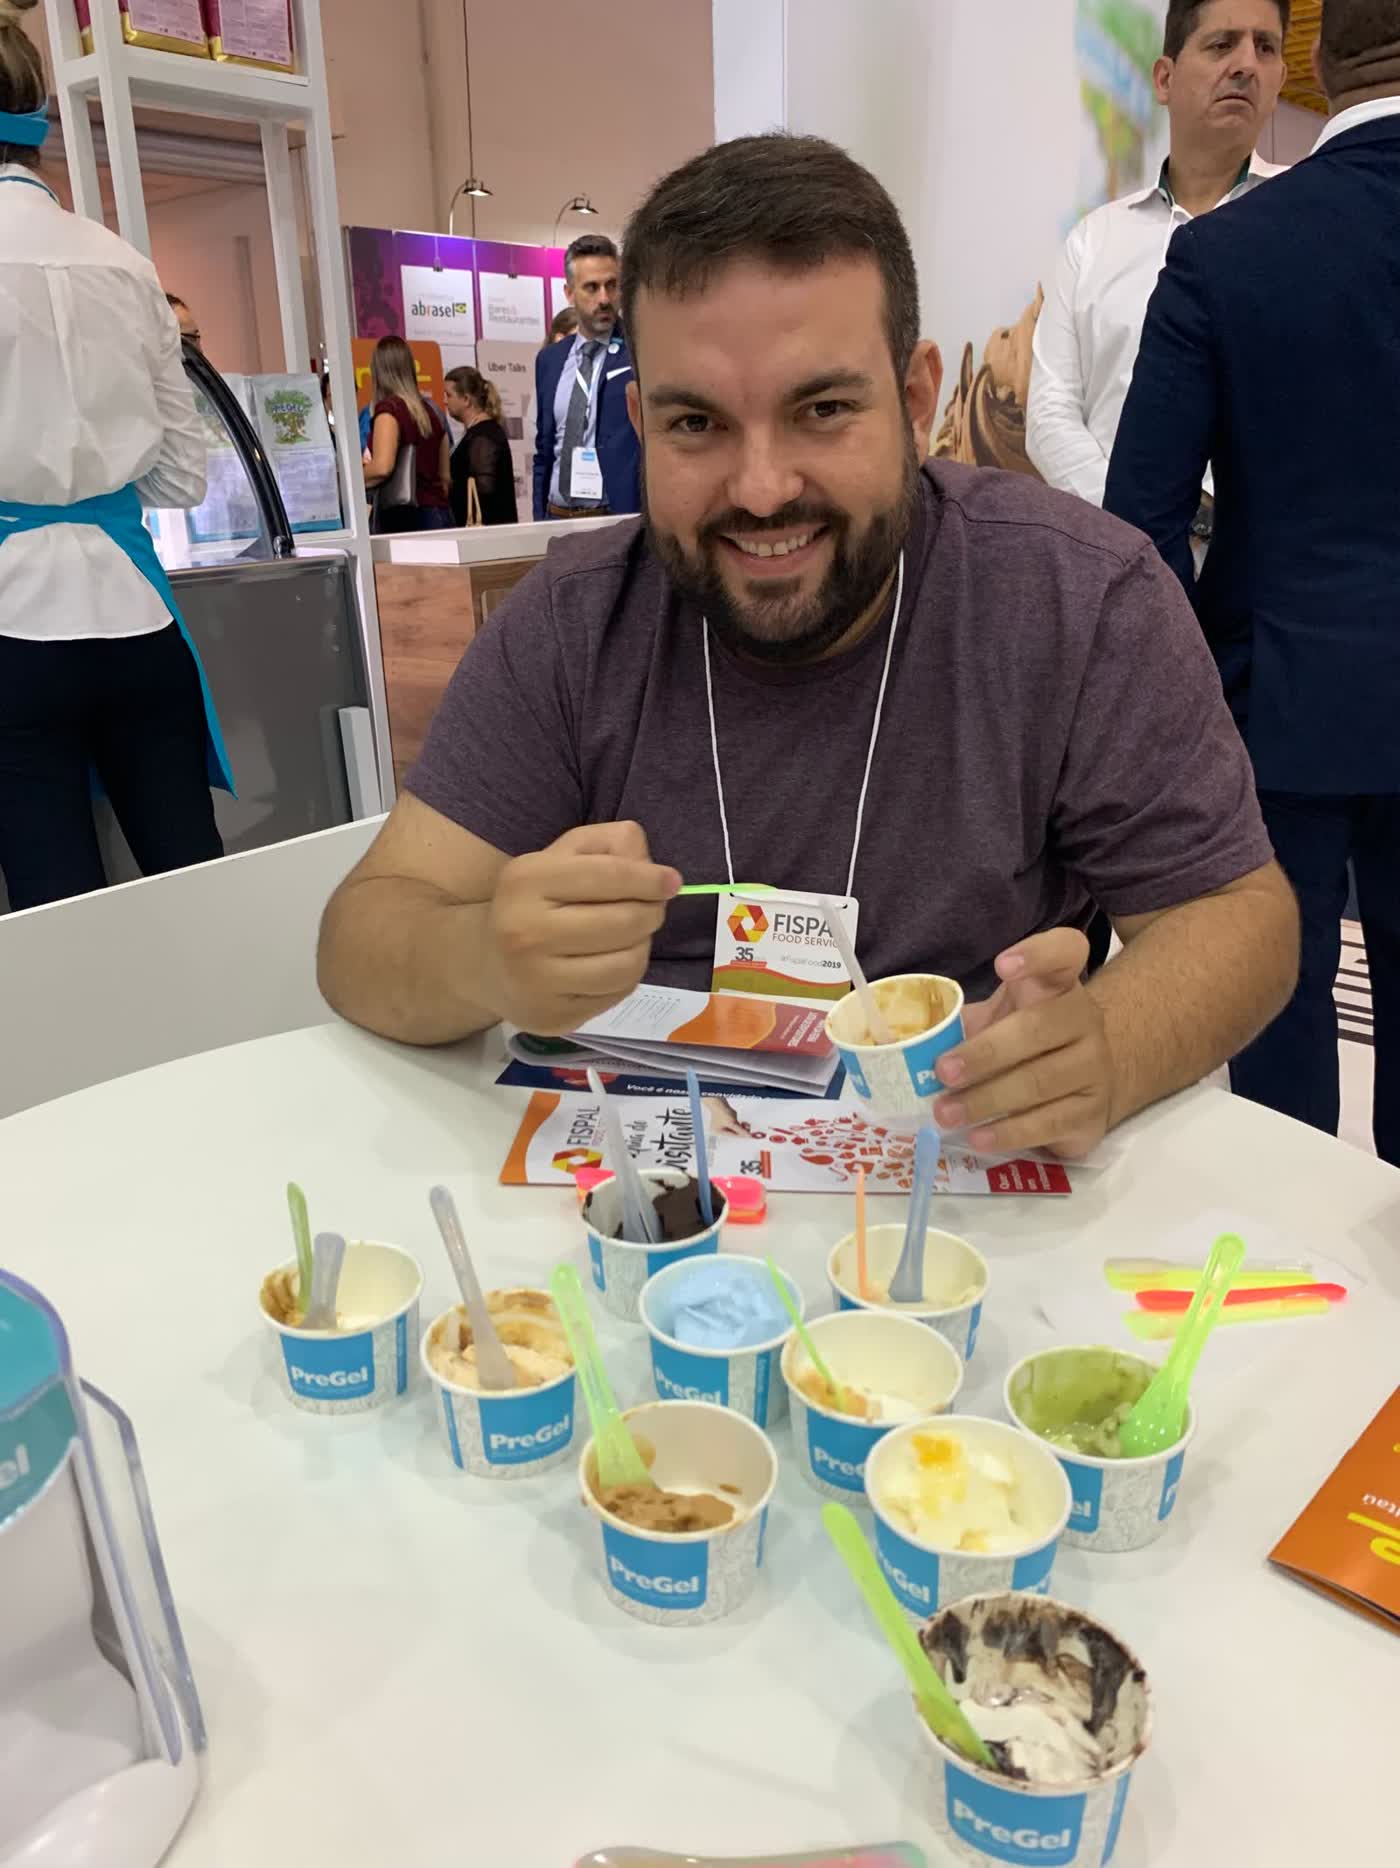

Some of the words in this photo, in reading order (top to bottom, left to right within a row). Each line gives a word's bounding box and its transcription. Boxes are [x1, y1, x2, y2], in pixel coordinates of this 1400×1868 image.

[411, 300, 456, 318] abrasel
[488, 362, 507, 372] Uber
[508, 362, 527, 373] Talks
[773, 913, 834, 938] FISPA
[772, 933, 803, 944] FOOD
[804, 936, 840, 949] SERVIC
[735, 946, 754, 961] 35
[626, 1084, 655, 1093] Você
[567, 1105, 600, 1146] FISPAL
[740, 1159, 763, 1176] 35
[290, 1365, 369, 1387] PreGel
[655, 1367, 721, 1404] PreGel
[490, 1413, 569, 1449] PreGel
[611, 1555, 699, 1593] PreGel
[953, 1799, 1071, 1849] PreGel
